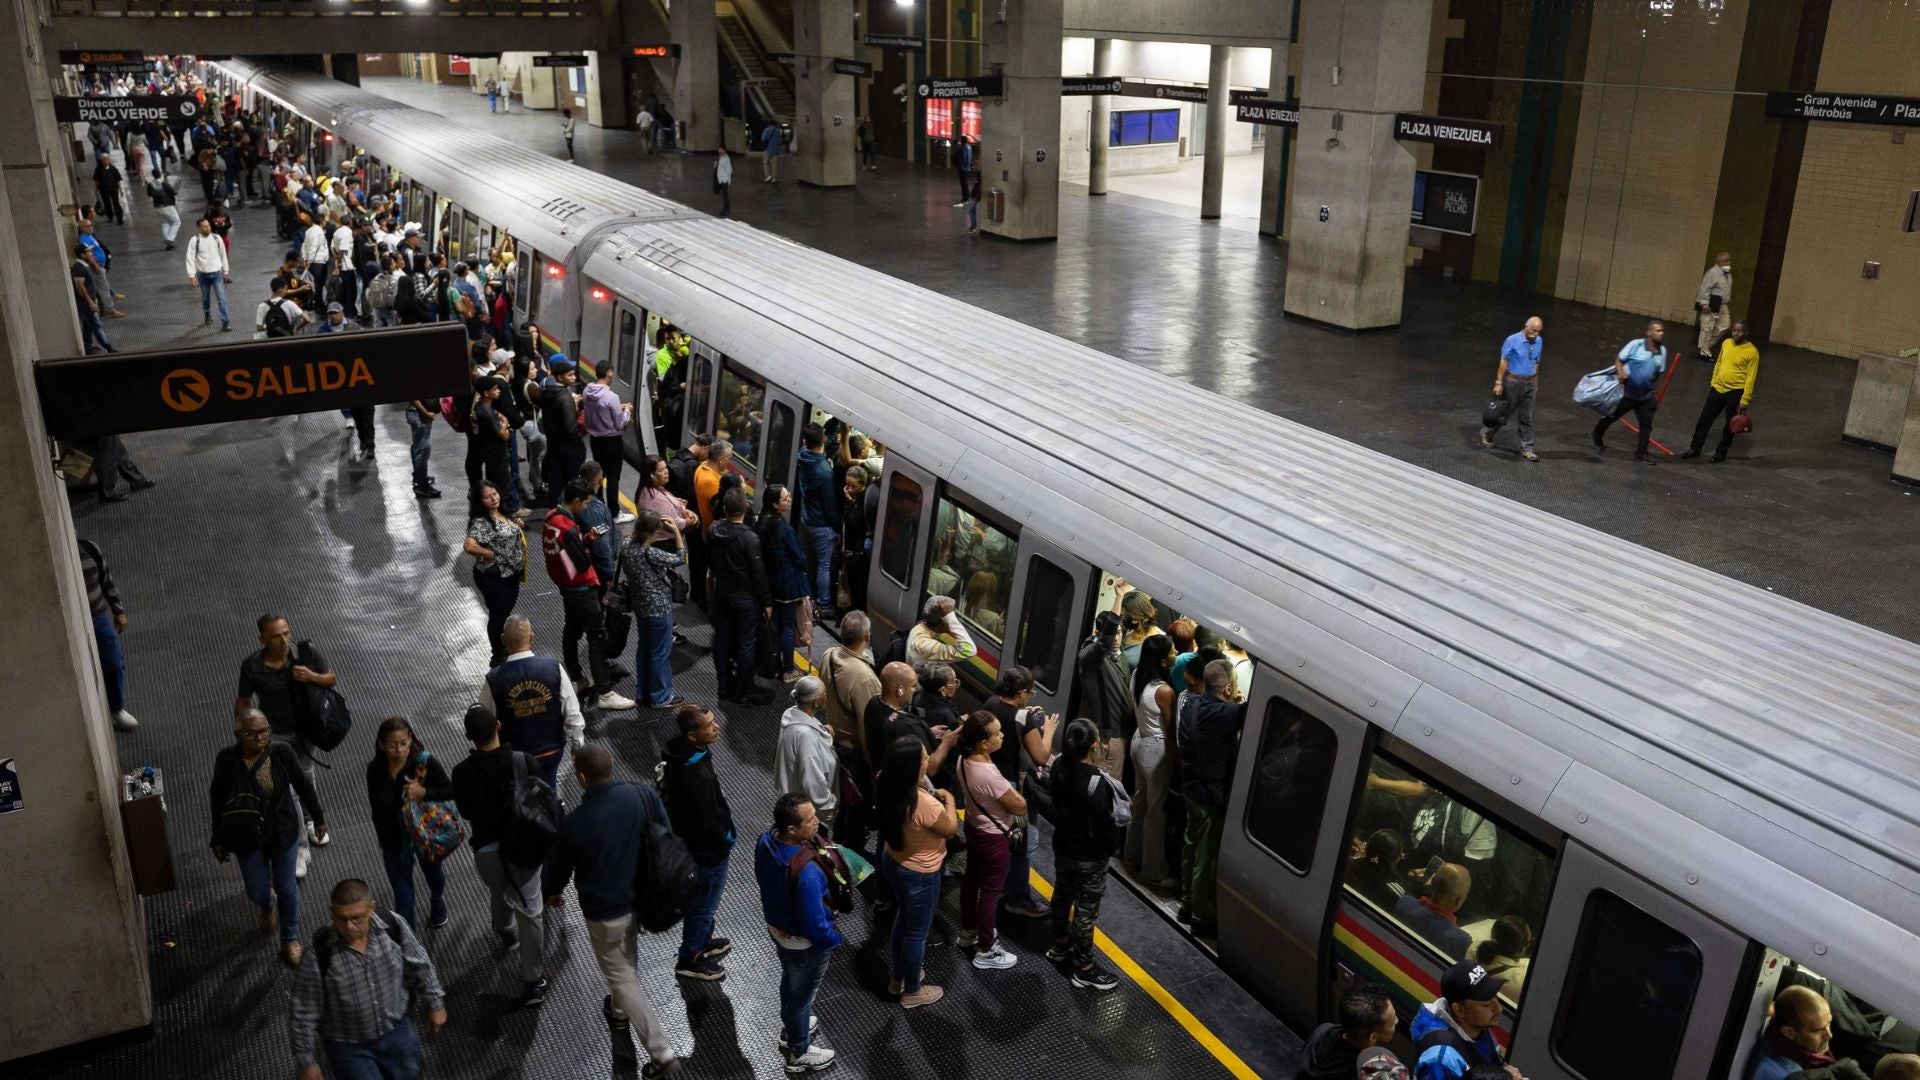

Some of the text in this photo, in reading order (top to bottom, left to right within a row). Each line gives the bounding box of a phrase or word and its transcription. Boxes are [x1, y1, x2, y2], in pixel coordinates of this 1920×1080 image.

[92, 53, 125, 61] SALIDA
[933, 87, 978, 97] PROPATRIA
[78, 99, 134, 108] Dirección
[1833, 96, 1877, 108] Avenida
[80, 108, 168, 120] PALO VERDE
[1240, 105, 1264, 118] PLAZA
[1803, 106, 1852, 119] Metrobús
[1400, 121, 1492, 144] PLAZA VENEZUELA
[225, 357, 375, 400] SALIDA
